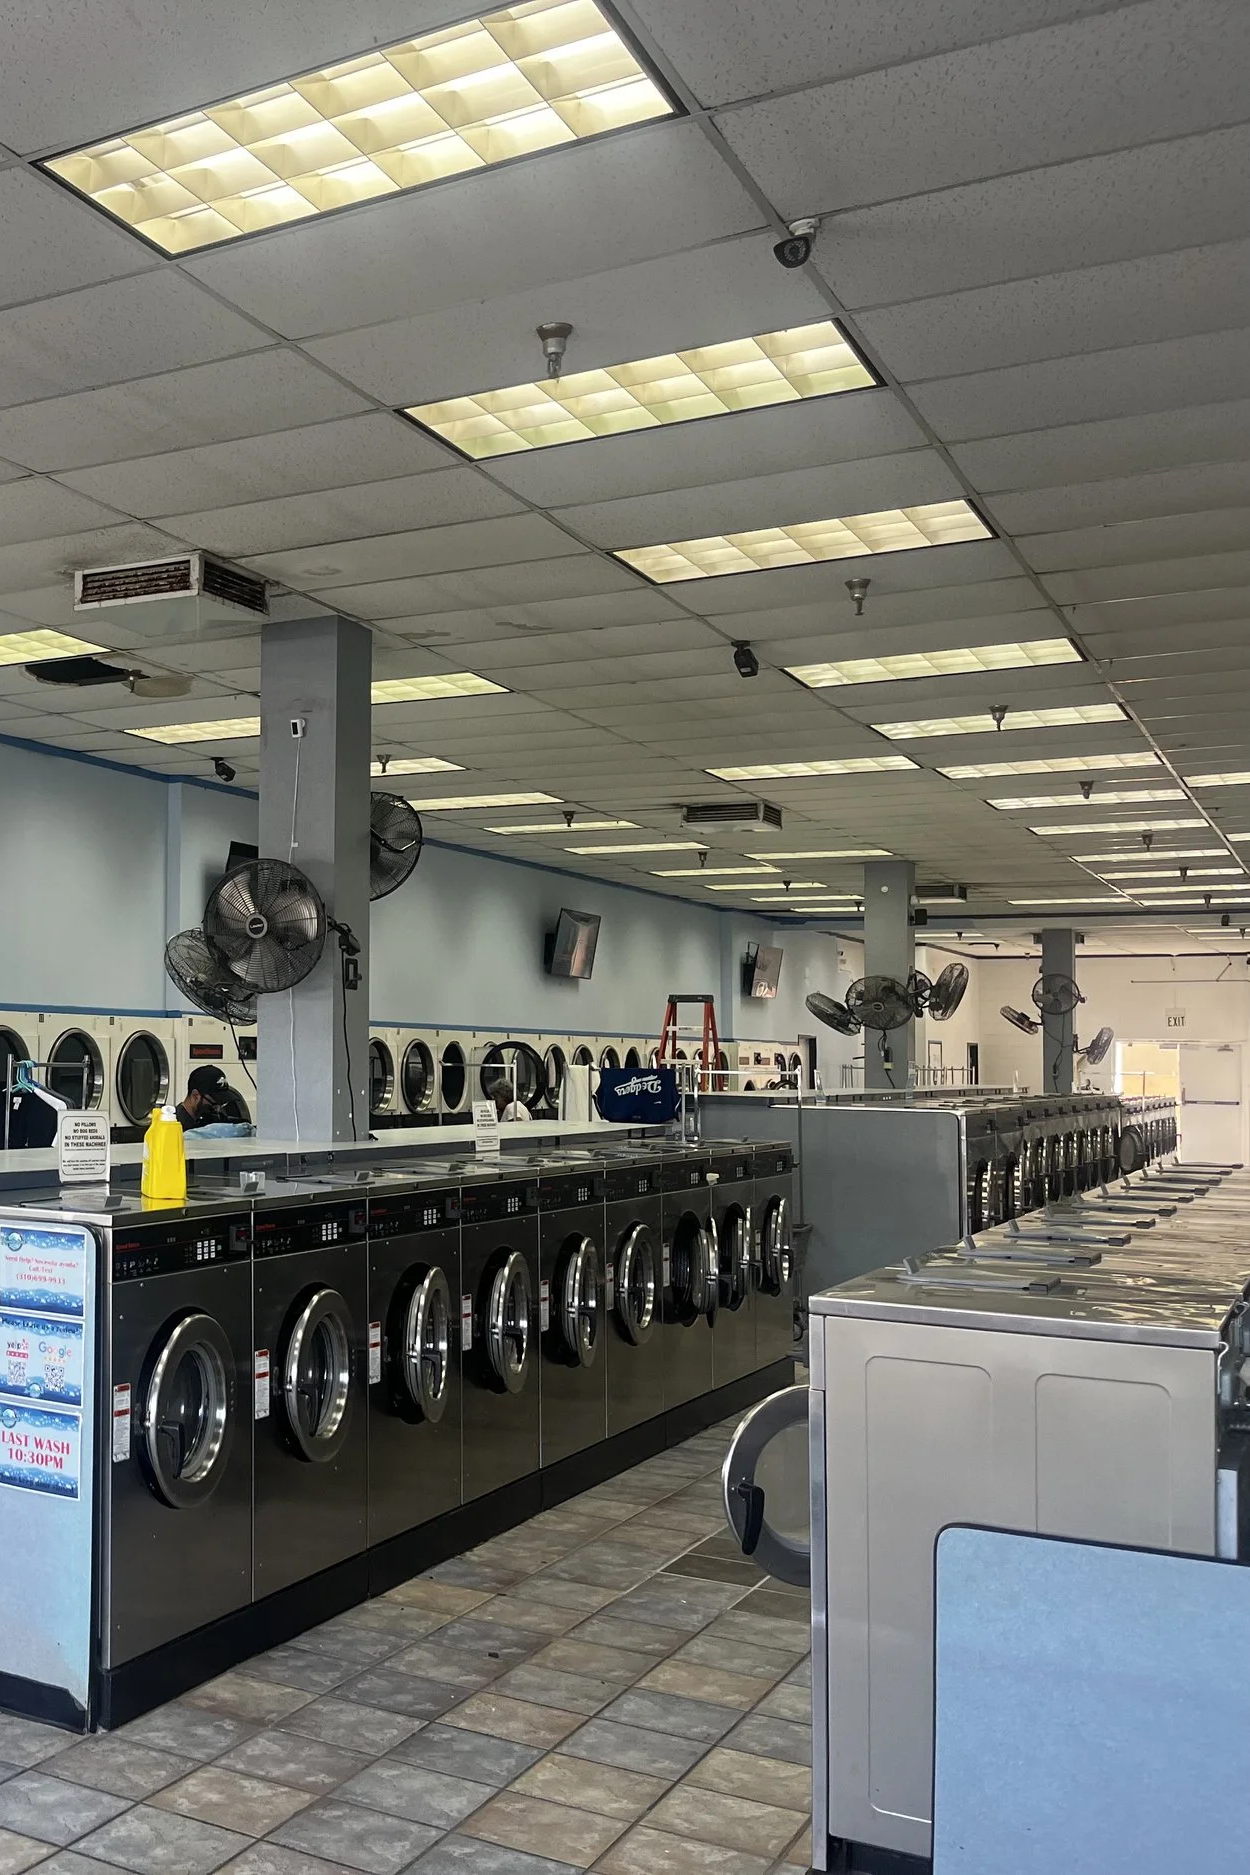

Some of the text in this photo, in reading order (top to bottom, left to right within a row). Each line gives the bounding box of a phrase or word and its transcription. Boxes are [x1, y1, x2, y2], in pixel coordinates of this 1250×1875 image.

[1167, 1016, 1185, 1027] EXIT
[614, 1074, 662, 1096] Dodgers
[6, 1340, 72, 1358] yelp Google
[1, 1430, 71, 1456] LAST WASH
[8, 1448, 64, 1470] 10:30PM
